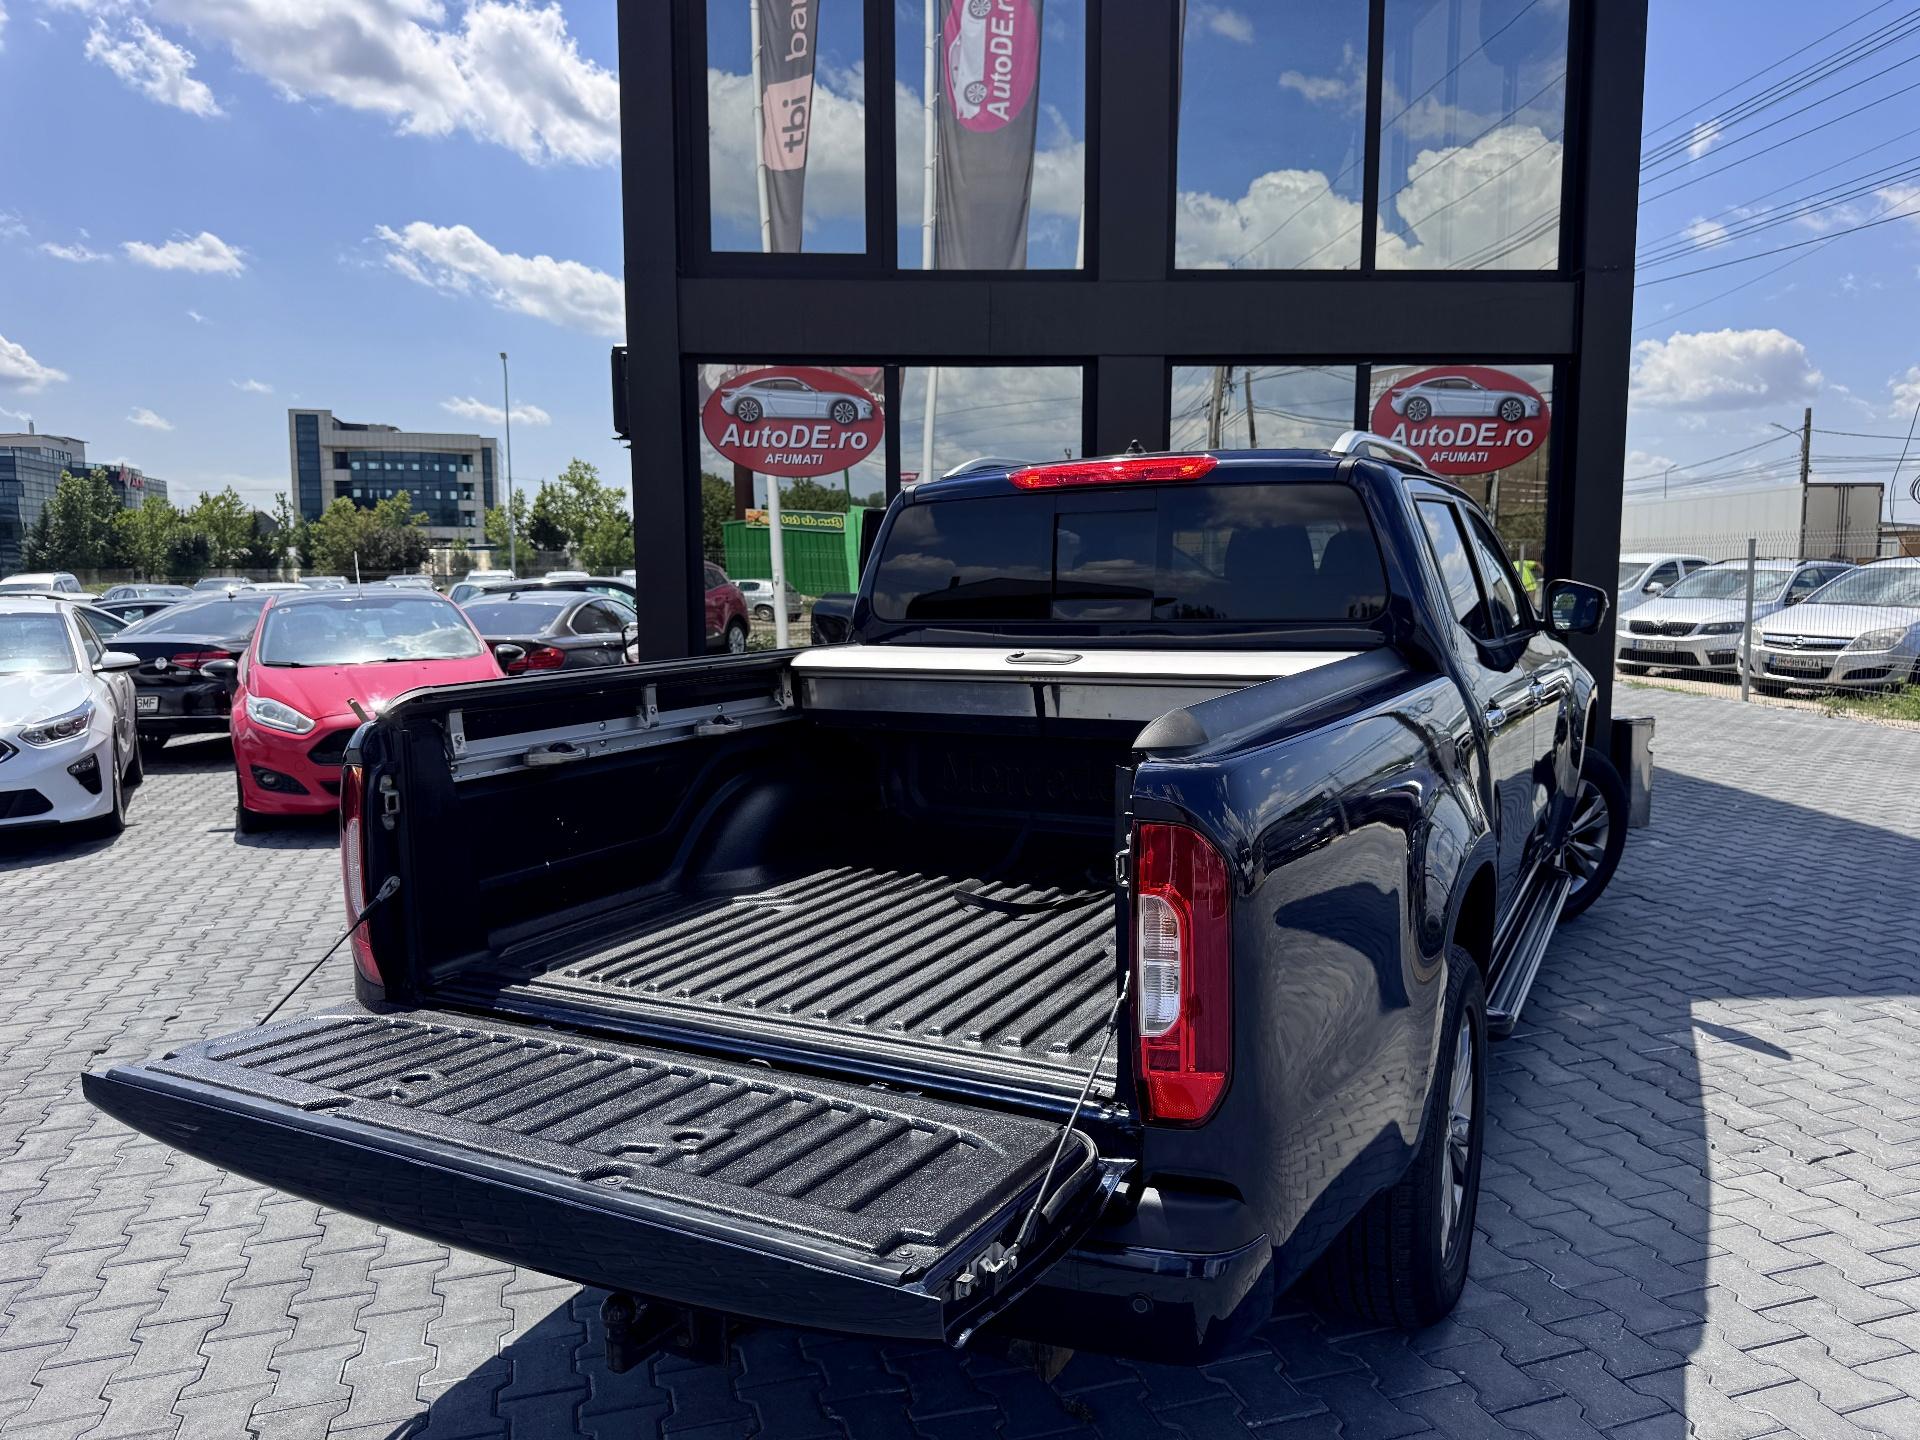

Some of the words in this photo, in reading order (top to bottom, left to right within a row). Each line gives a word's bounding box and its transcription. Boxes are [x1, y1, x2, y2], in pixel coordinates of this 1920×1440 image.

[782, 95, 807, 154] tbi
[720, 423, 868, 450] AutoDE.ro
[1389, 422, 1534, 448] AutoDE.ro
[764, 453, 824, 465] AFUMATI
[1430, 451, 1489, 463] AFUMATI
